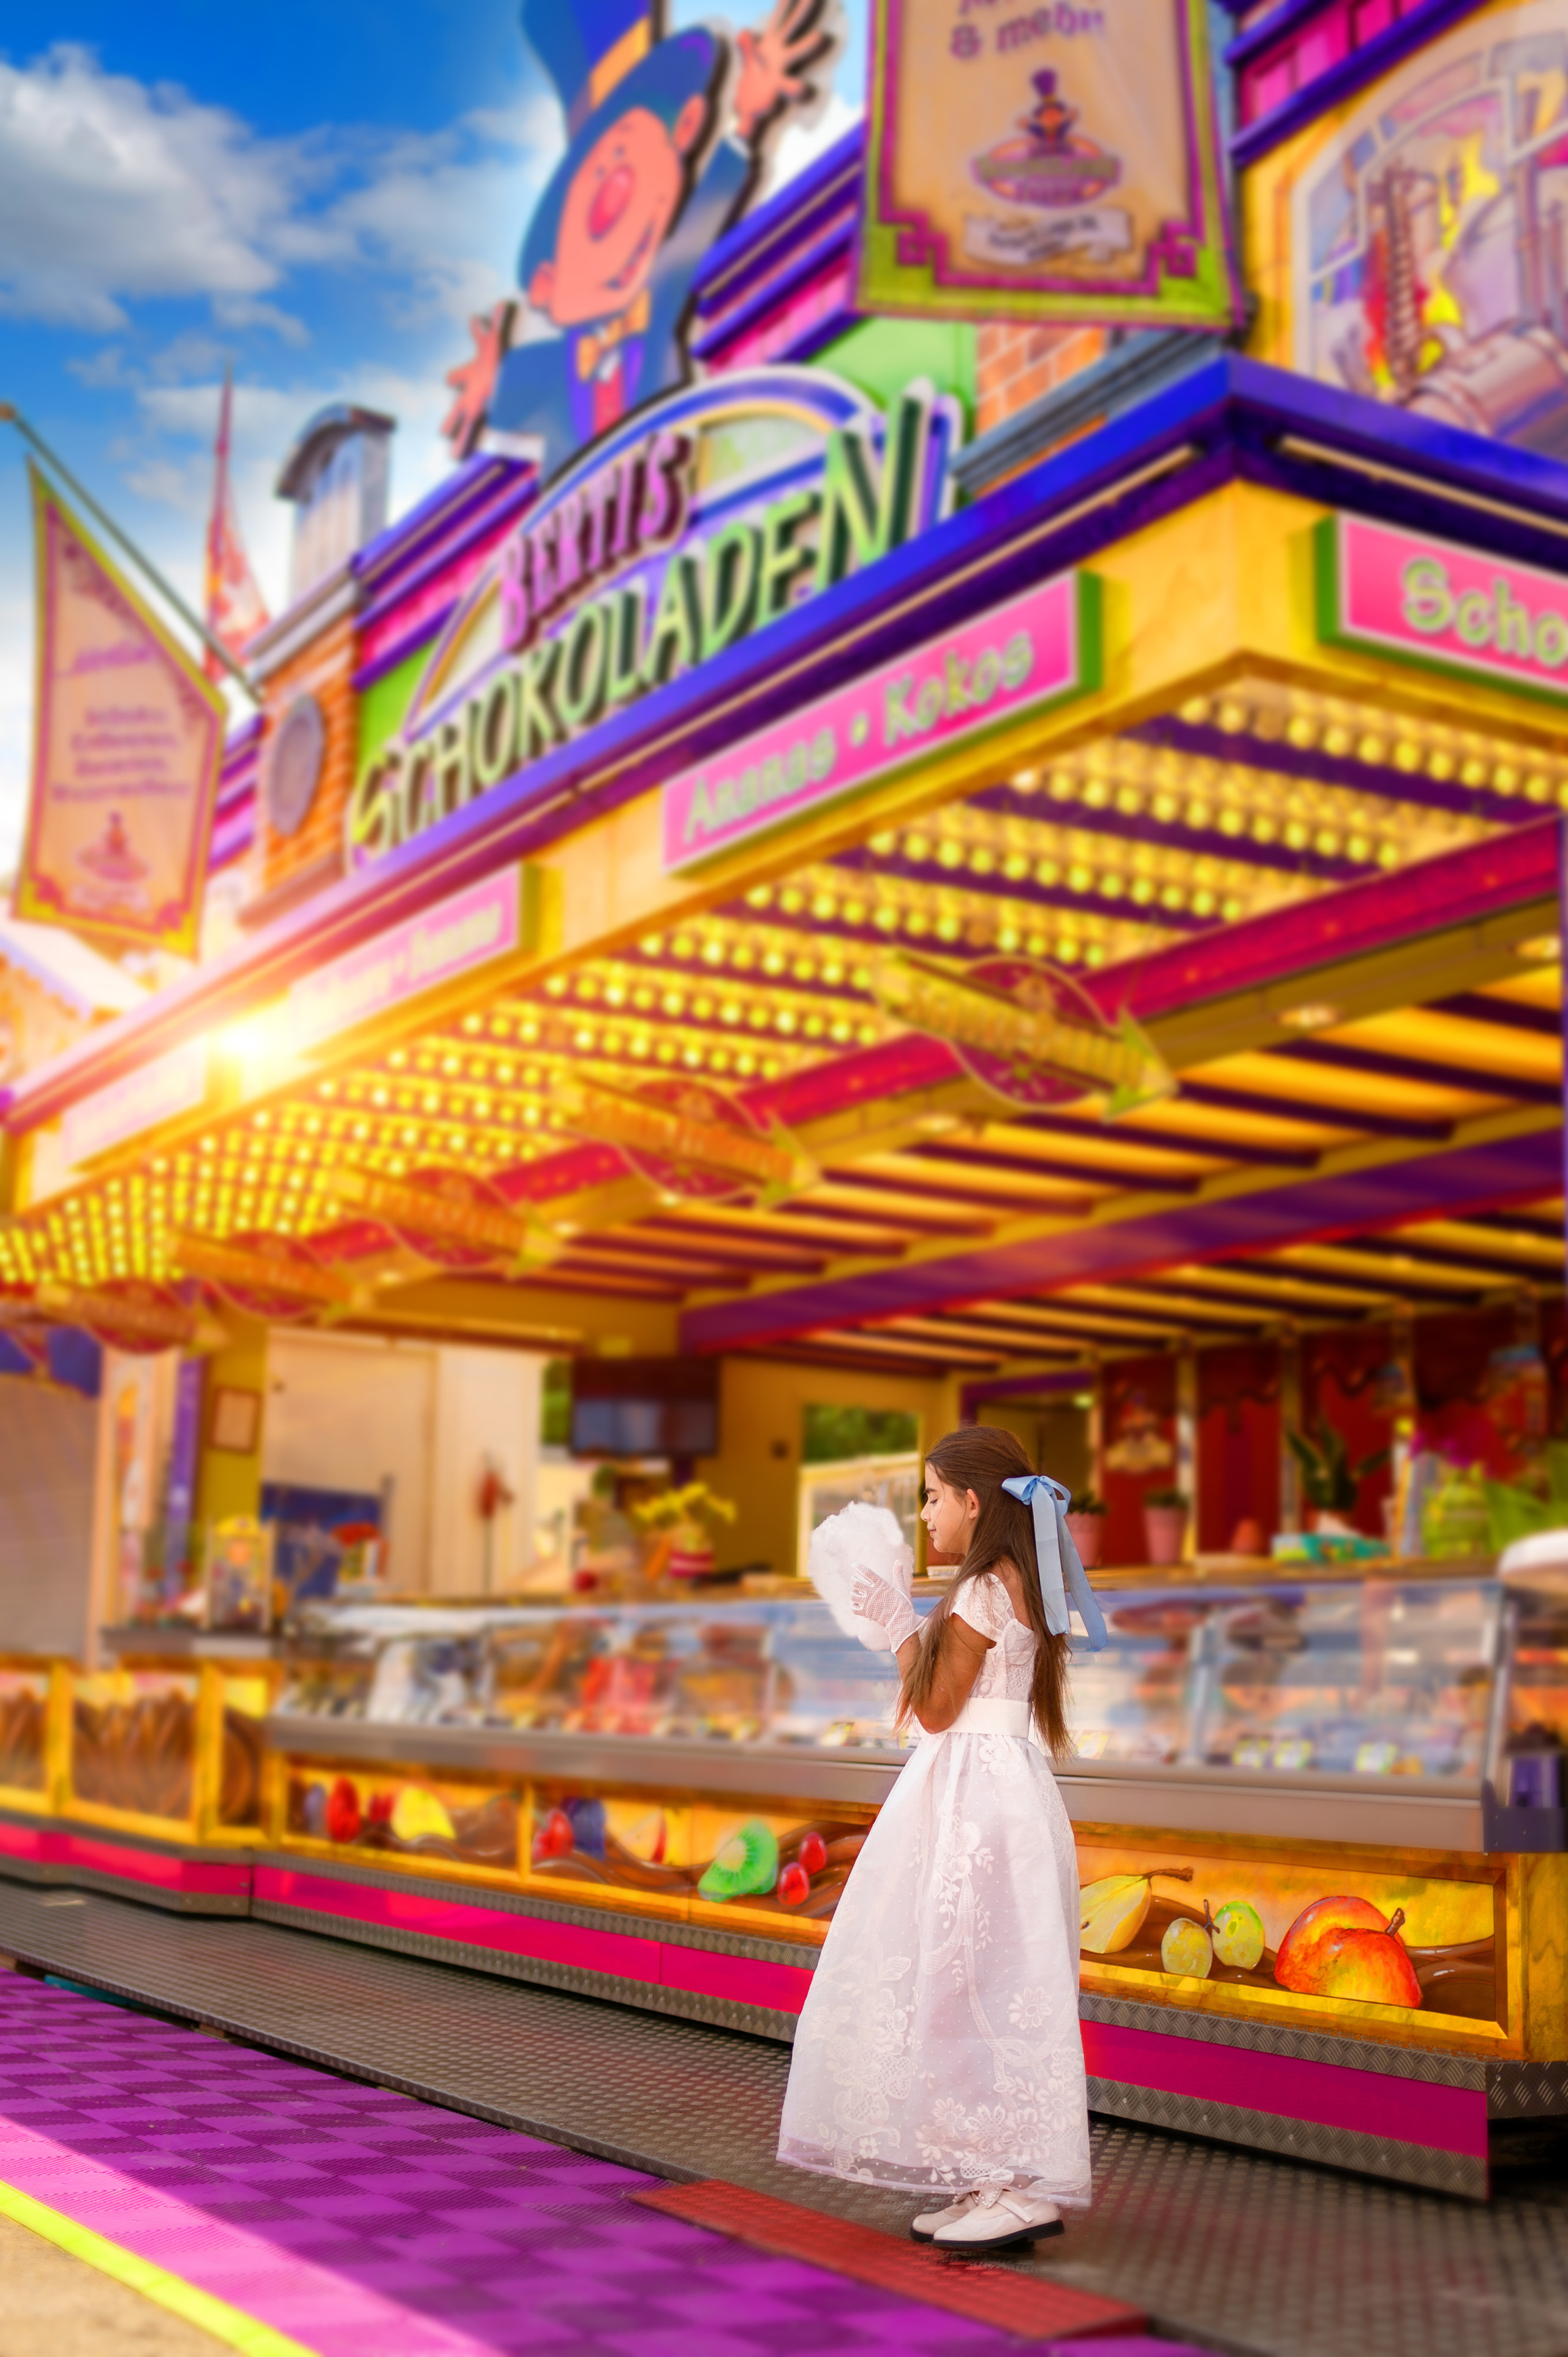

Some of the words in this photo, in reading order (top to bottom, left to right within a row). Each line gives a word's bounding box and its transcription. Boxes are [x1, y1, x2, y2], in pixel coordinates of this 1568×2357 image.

[350, 392, 929, 849] SCHOKOLADEN
[1401, 556, 1568, 670] Scho
[682, 726, 837, 846] Ananas
[882, 629, 1035, 748] Kokos
